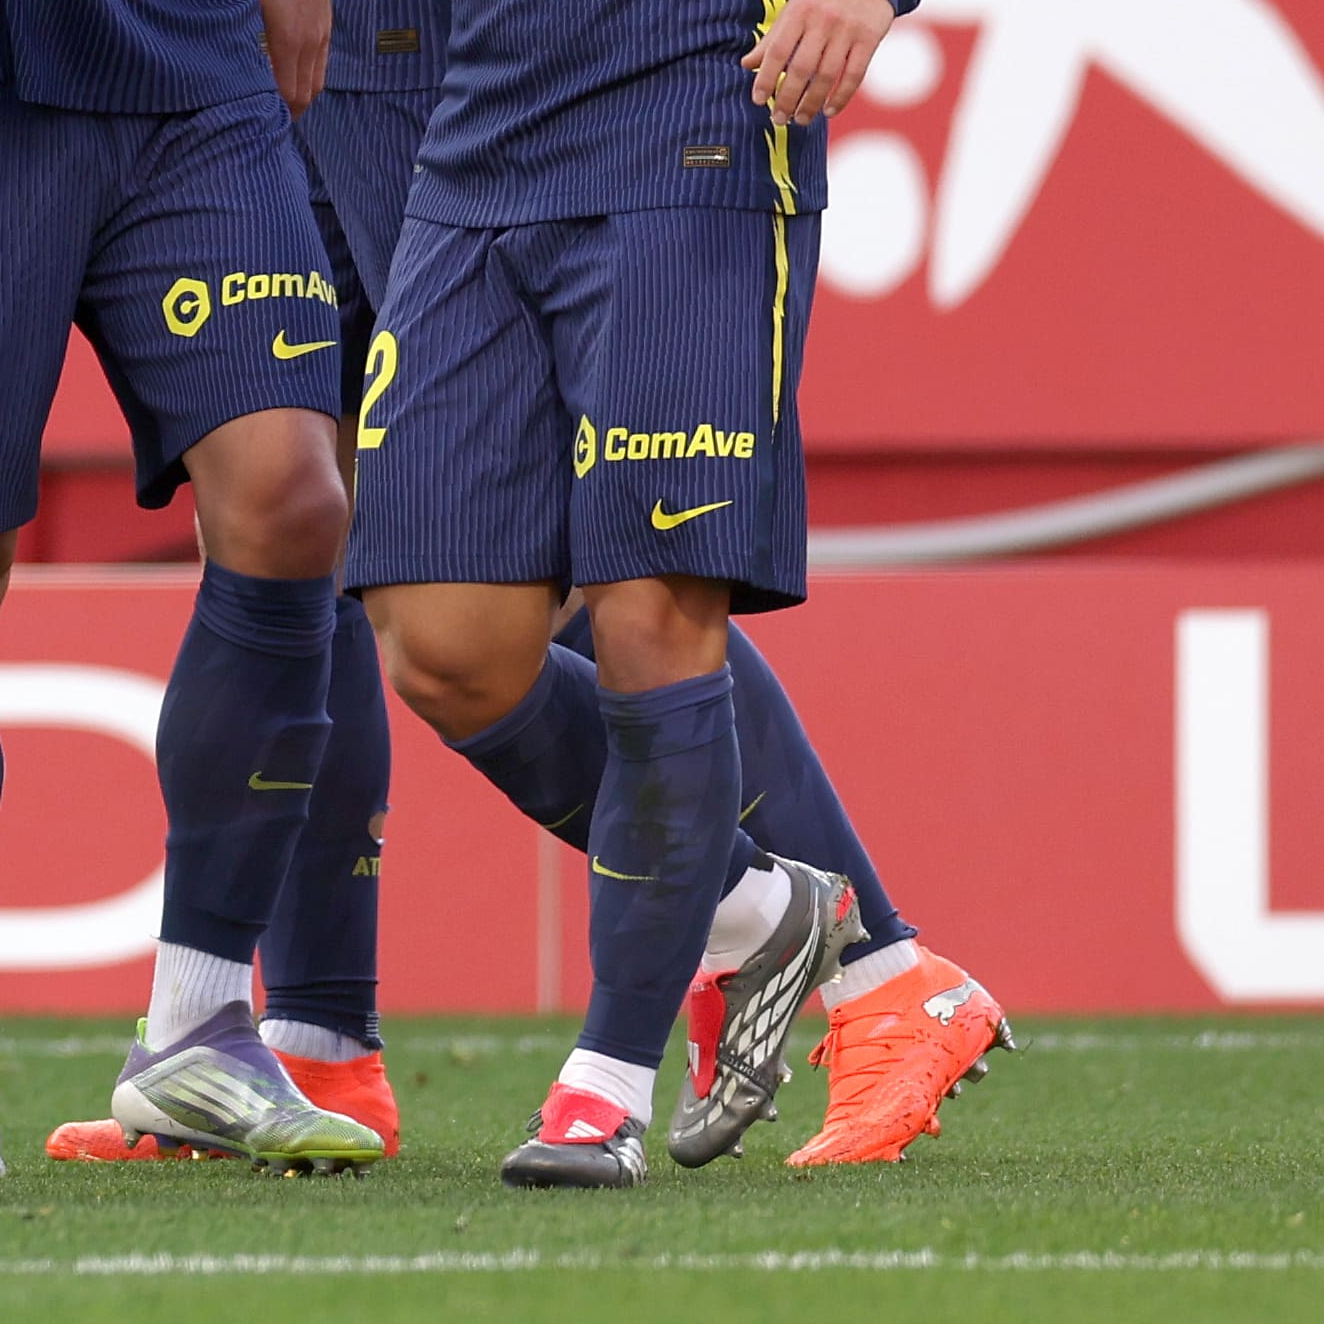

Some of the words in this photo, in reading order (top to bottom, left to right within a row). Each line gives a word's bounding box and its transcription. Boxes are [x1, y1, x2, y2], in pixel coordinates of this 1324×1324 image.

[221, 270, 339, 312] ComAv
[356, 329, 399, 450] 2
[604, 423, 755, 461] ComAve
